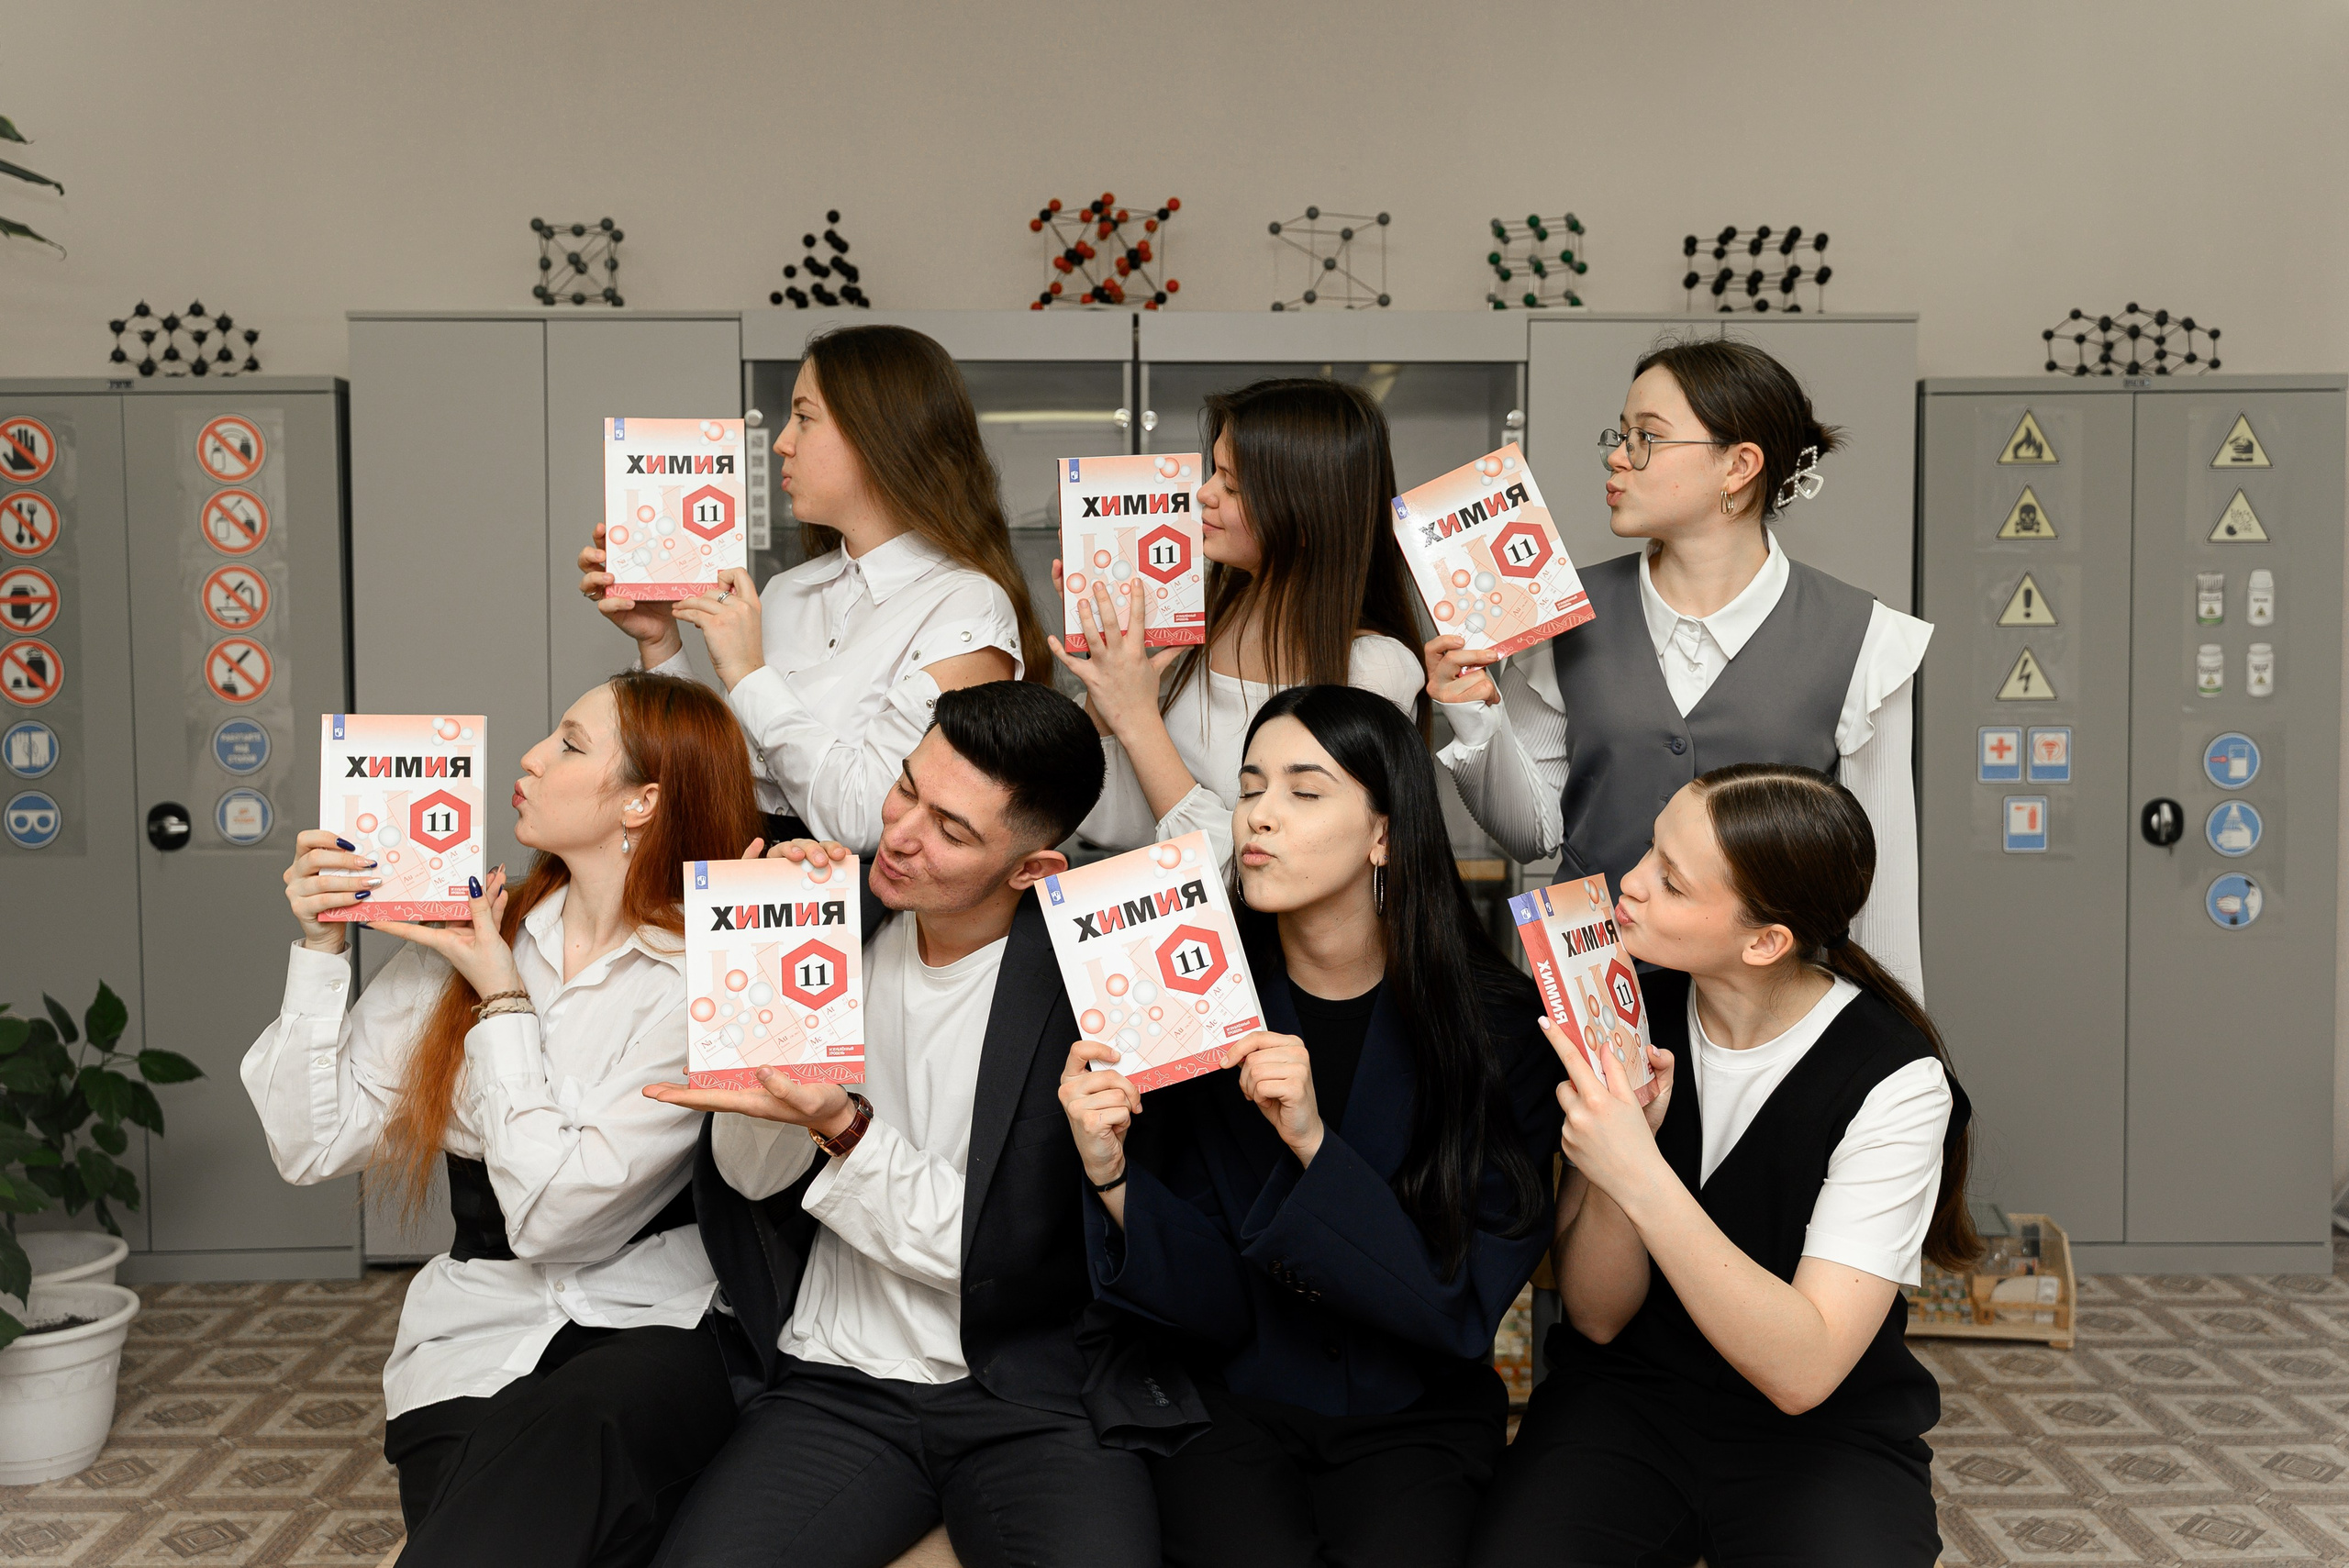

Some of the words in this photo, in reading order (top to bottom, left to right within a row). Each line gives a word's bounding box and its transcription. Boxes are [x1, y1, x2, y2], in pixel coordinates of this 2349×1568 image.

[626, 454, 734, 474] ХИМИЯ
[697, 504, 721, 522] 11
[1082, 492, 1190, 517] ХИМИЯ
[1419, 482, 1531, 548] ХИМИЯ
[1152, 544, 1177, 564] 11
[1508, 538, 1537, 564] 11
[345, 756, 472, 778] ХИМИЯ
[427, 812, 454, 832] 11
[710, 900, 846, 931] ХИМИЯ
[1072, 878, 1208, 943] ХИМИЯ
[1562, 918, 1620, 958] ХИМИЯ
[1175, 946, 1210, 975] 11
[799, 963, 830, 987] 11
[1536, 959, 1569, 1025] ХИМИЯ
[1616, 981, 1634, 1006] 11
